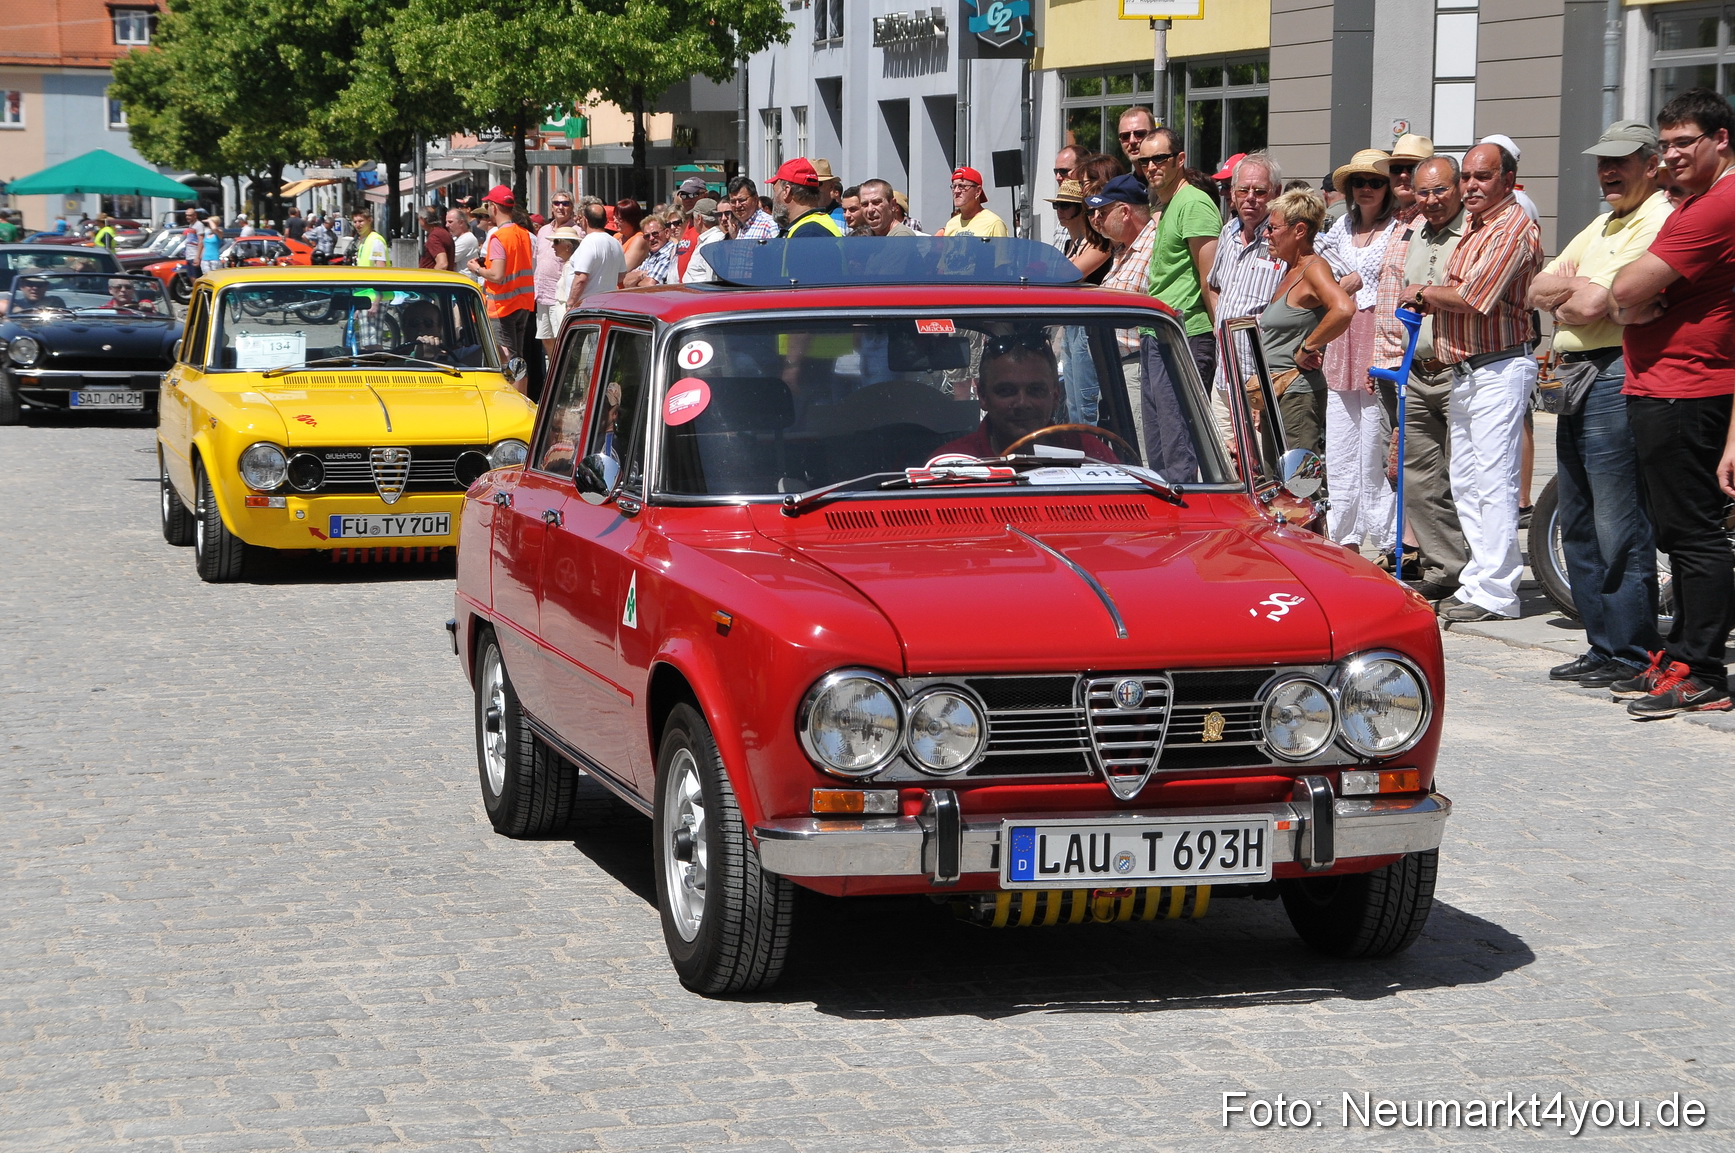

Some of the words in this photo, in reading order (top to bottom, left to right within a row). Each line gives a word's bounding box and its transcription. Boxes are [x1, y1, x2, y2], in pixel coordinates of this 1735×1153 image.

[987, 1, 1013, 33] G2
[270, 341, 291, 351] 134
[78, 393, 100, 404] SAD
[342, 518, 368, 535] FÜ
[382, 517, 407, 534] TY
[1018, 860, 1027, 871] D
[1039, 832, 1111, 874] LAU
[1142, 831, 1163, 872] T
[1173, 828, 1264, 871] 693H
